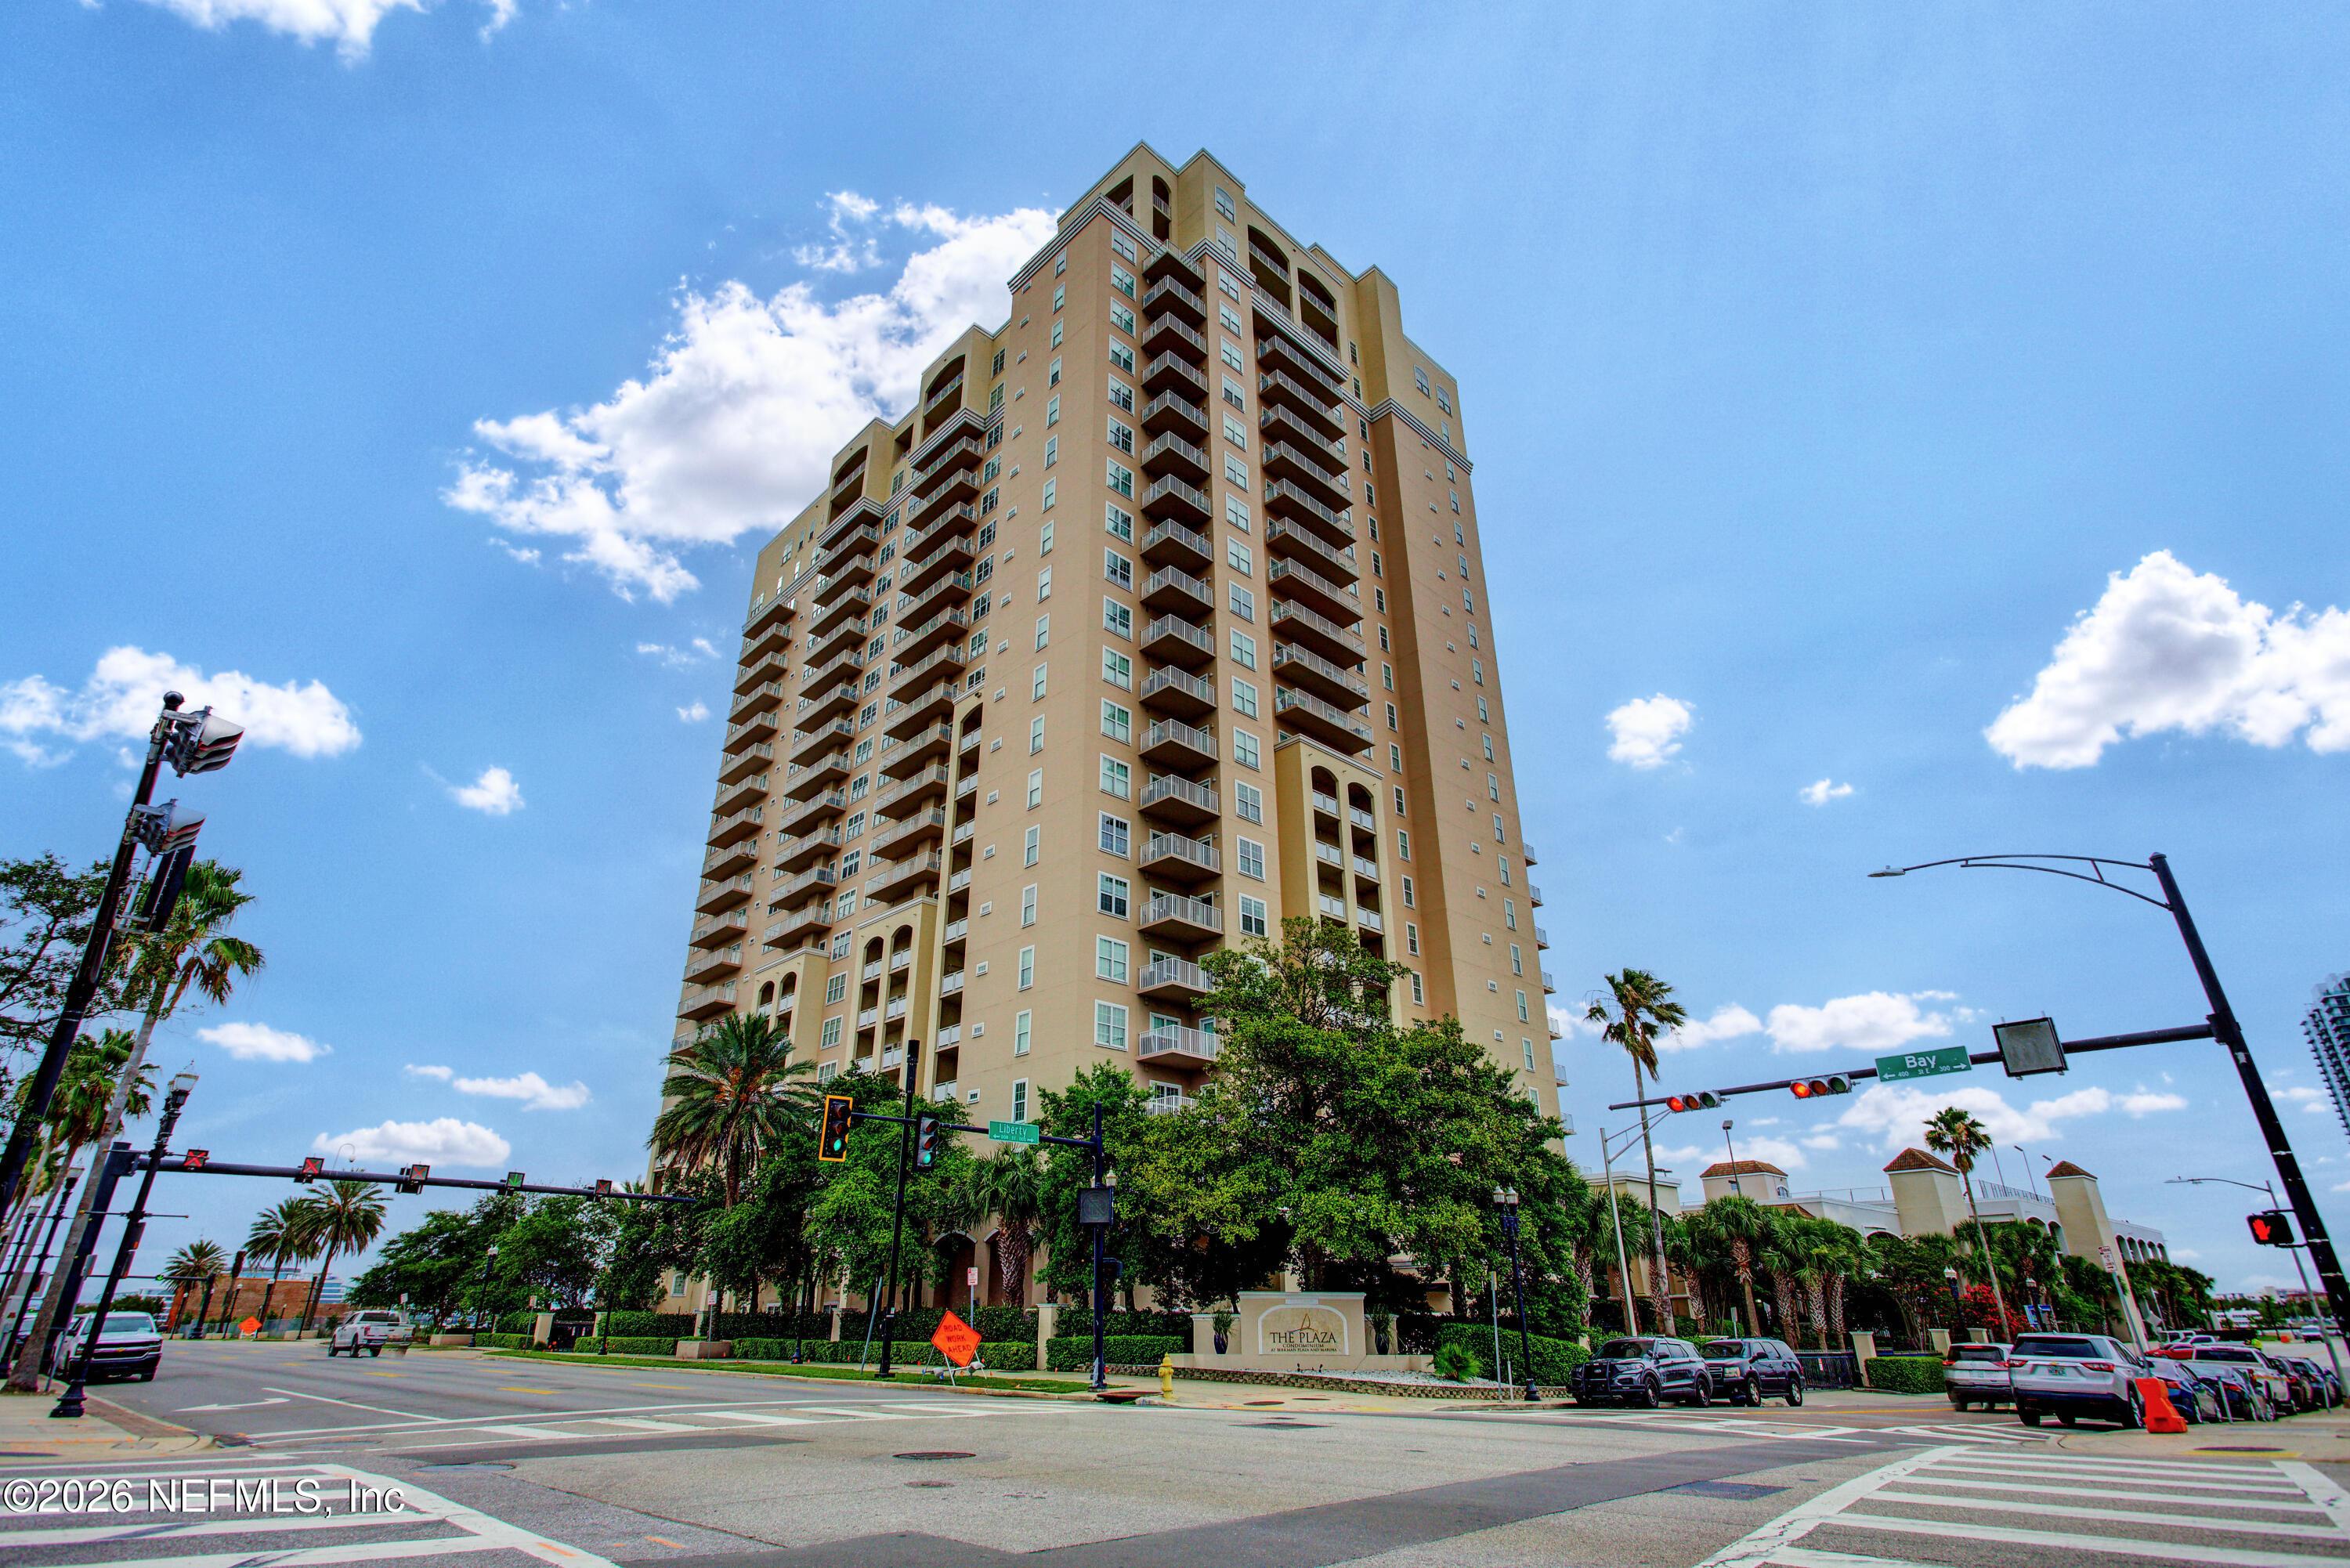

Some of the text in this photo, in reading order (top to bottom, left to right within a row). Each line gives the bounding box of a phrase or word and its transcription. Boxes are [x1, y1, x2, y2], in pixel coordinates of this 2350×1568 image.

[1904, 1055, 1936, 1068] Bay
[999, 1123, 1027, 1137] Liberty
[1270, 1331, 1336, 1343] THE PLAZA
[949, 1344, 971, 1353] AHEAD
